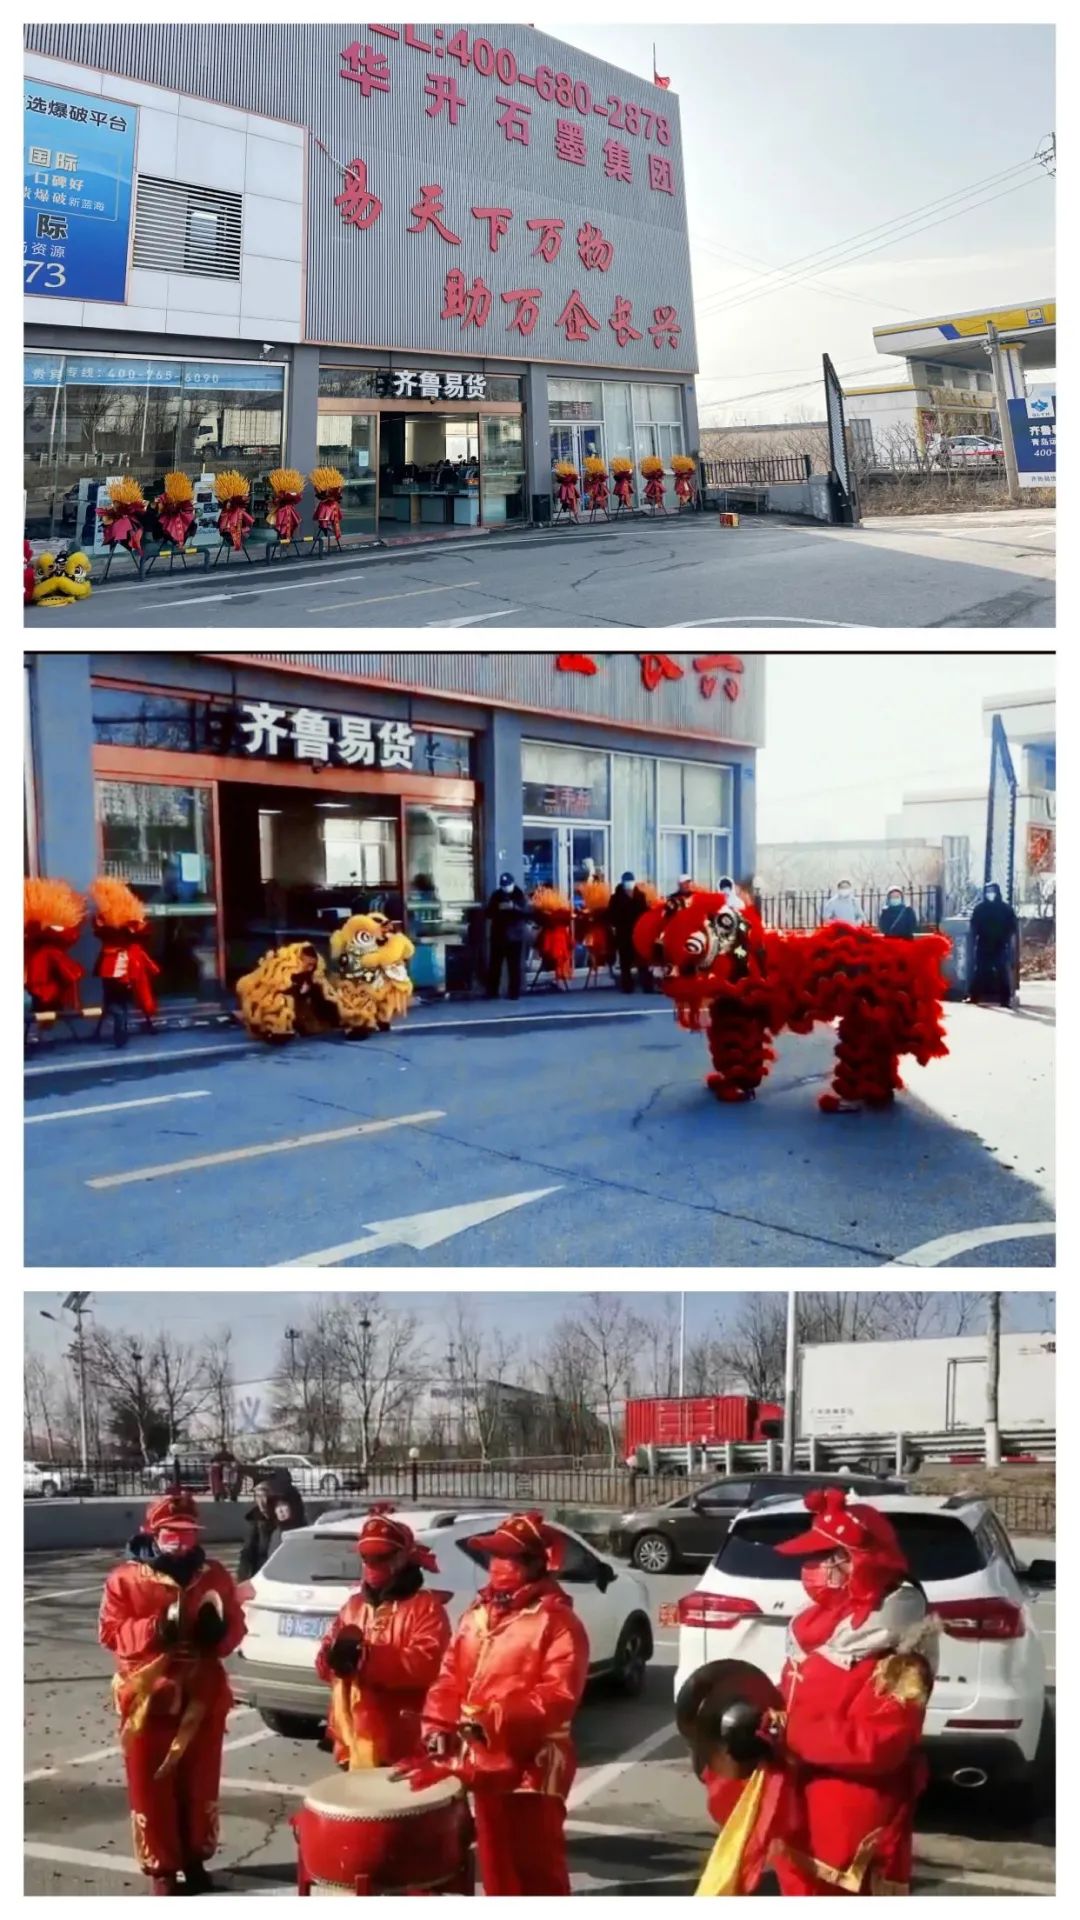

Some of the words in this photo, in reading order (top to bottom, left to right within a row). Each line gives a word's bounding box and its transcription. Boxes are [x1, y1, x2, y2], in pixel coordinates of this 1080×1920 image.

[339, 40, 676, 197] 华升石墨集团
[29, 146, 79, 173] 国际
[34, 171, 84, 191] 口碑好
[334, 158, 613, 272] 易天下万物
[24, 259, 66, 288] 73
[440, 268, 682, 350] 助万企长兴
[393, 371, 487, 400] 齐鲁易货
[241, 701, 416, 770] 齐鲁易货
